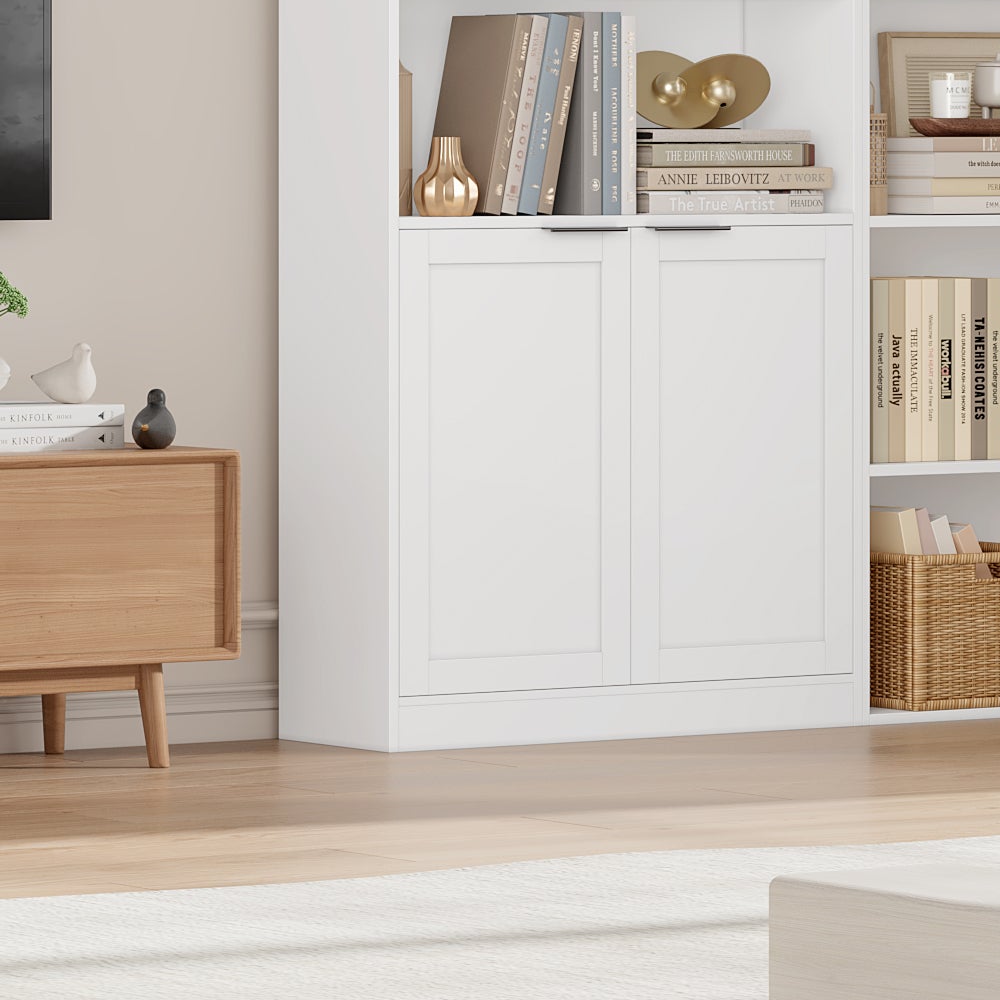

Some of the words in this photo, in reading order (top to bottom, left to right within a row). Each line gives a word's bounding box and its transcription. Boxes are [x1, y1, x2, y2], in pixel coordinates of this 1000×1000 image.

[520, 32, 529, 61] MAEVE
[666, 150, 682, 162] THE
[684, 150, 708, 162] EDITH
[710, 150, 764, 162] FARNSWORTH
[766, 150, 793, 161] HOUSE
[657, 173, 698, 185] ANNIE
[705, 173, 770, 185] LEIBOVITZ
[777, 174, 792, 183] AT
[794, 173, 825, 182] WORK
[669, 197, 694, 212] The
[700, 197, 728, 211] True
[734, 197, 775, 211] Artist
[790, 199, 823, 208] PHAIDON
[892, 334, 902, 358] Java
[910, 328, 918, 349] THE
[974, 317, 985, 374] TA-NEHISI
[889, 363, 902, 407] actually
[910, 350, 918, 413] IMMACULATE
[991, 363, 999, 405] underground
[974, 376, 985, 420] COATES
[10, 413, 53, 422] KINFOLK
[12, 436, 54, 445] KINFOLK
